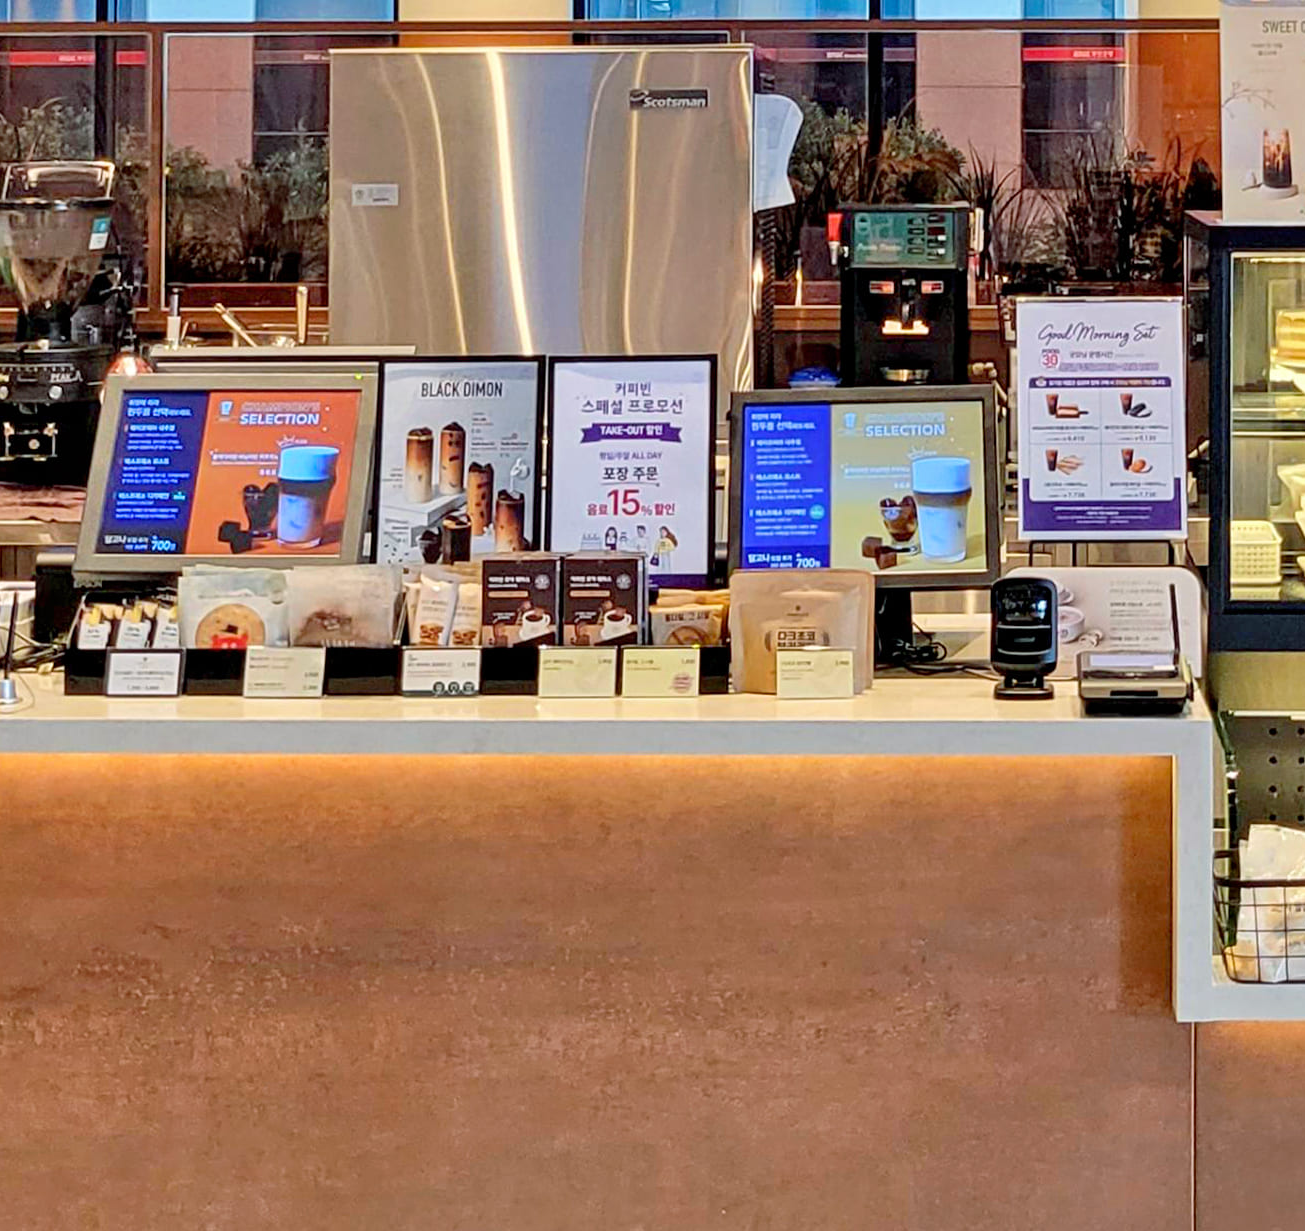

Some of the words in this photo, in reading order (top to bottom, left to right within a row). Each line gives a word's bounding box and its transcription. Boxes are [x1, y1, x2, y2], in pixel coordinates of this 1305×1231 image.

[1261, 20, 1299, 34] SWEET
[642, 96, 707, 109] Scotsman
[1038, 323, 1075, 346] Good
[1072, 321, 1131, 348] Morning
[1132, 322, 1161, 340] Set
[421, 381, 460, 398] BLACK
[463, 381, 503, 397] DIMON
[615, 382, 652, 397] 커피빈
[581, 399, 623, 415] 스페셜
[627, 399, 683, 415] 프로모션
[239, 412, 321, 426] SELECTION
[600, 425, 644, 436] TAKE-OUT
[645, 424, 664, 436] 할인
[864, 423, 947, 438] SELECTION
[631, 451, 647, 460] ALL
[646, 451, 663, 460] DAY
[602, 466, 629, 481] 포장
[632, 466, 659, 481] 주문
[587, 503, 608, 517] 음료
[654, 503, 676, 516] 할인
[777, 631, 816, 641] 다크초코
